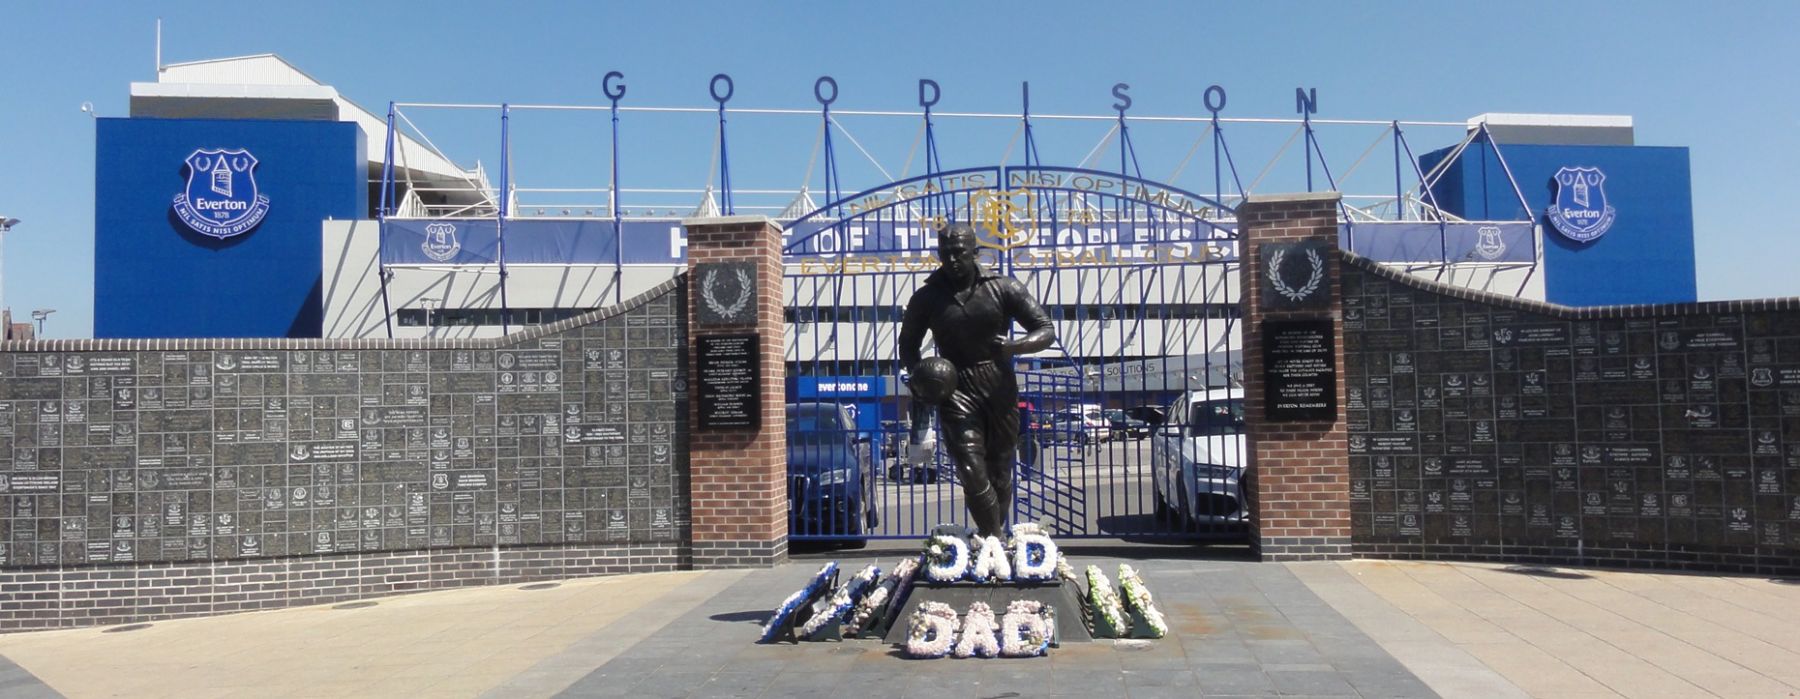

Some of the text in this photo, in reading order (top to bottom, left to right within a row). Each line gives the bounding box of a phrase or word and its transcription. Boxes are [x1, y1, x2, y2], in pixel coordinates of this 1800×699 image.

[196, 198, 247, 210] Everton
[900, 173, 986, 198] SATIS
[1010, 172, 1062, 187] NISI
[1072, 175, 1209, 219] OPTIMUM
[179, 207, 190, 221] NIL
[190, 218, 211, 233] SATIS
[232, 207, 264, 233] OPTIMUM
[1564, 208, 1600, 219] Everton
[813, 226, 869, 259] OF
[1003, 228, 1193, 260] PEOPLE'S
[973, 247, 1133, 269] OOTBALL
